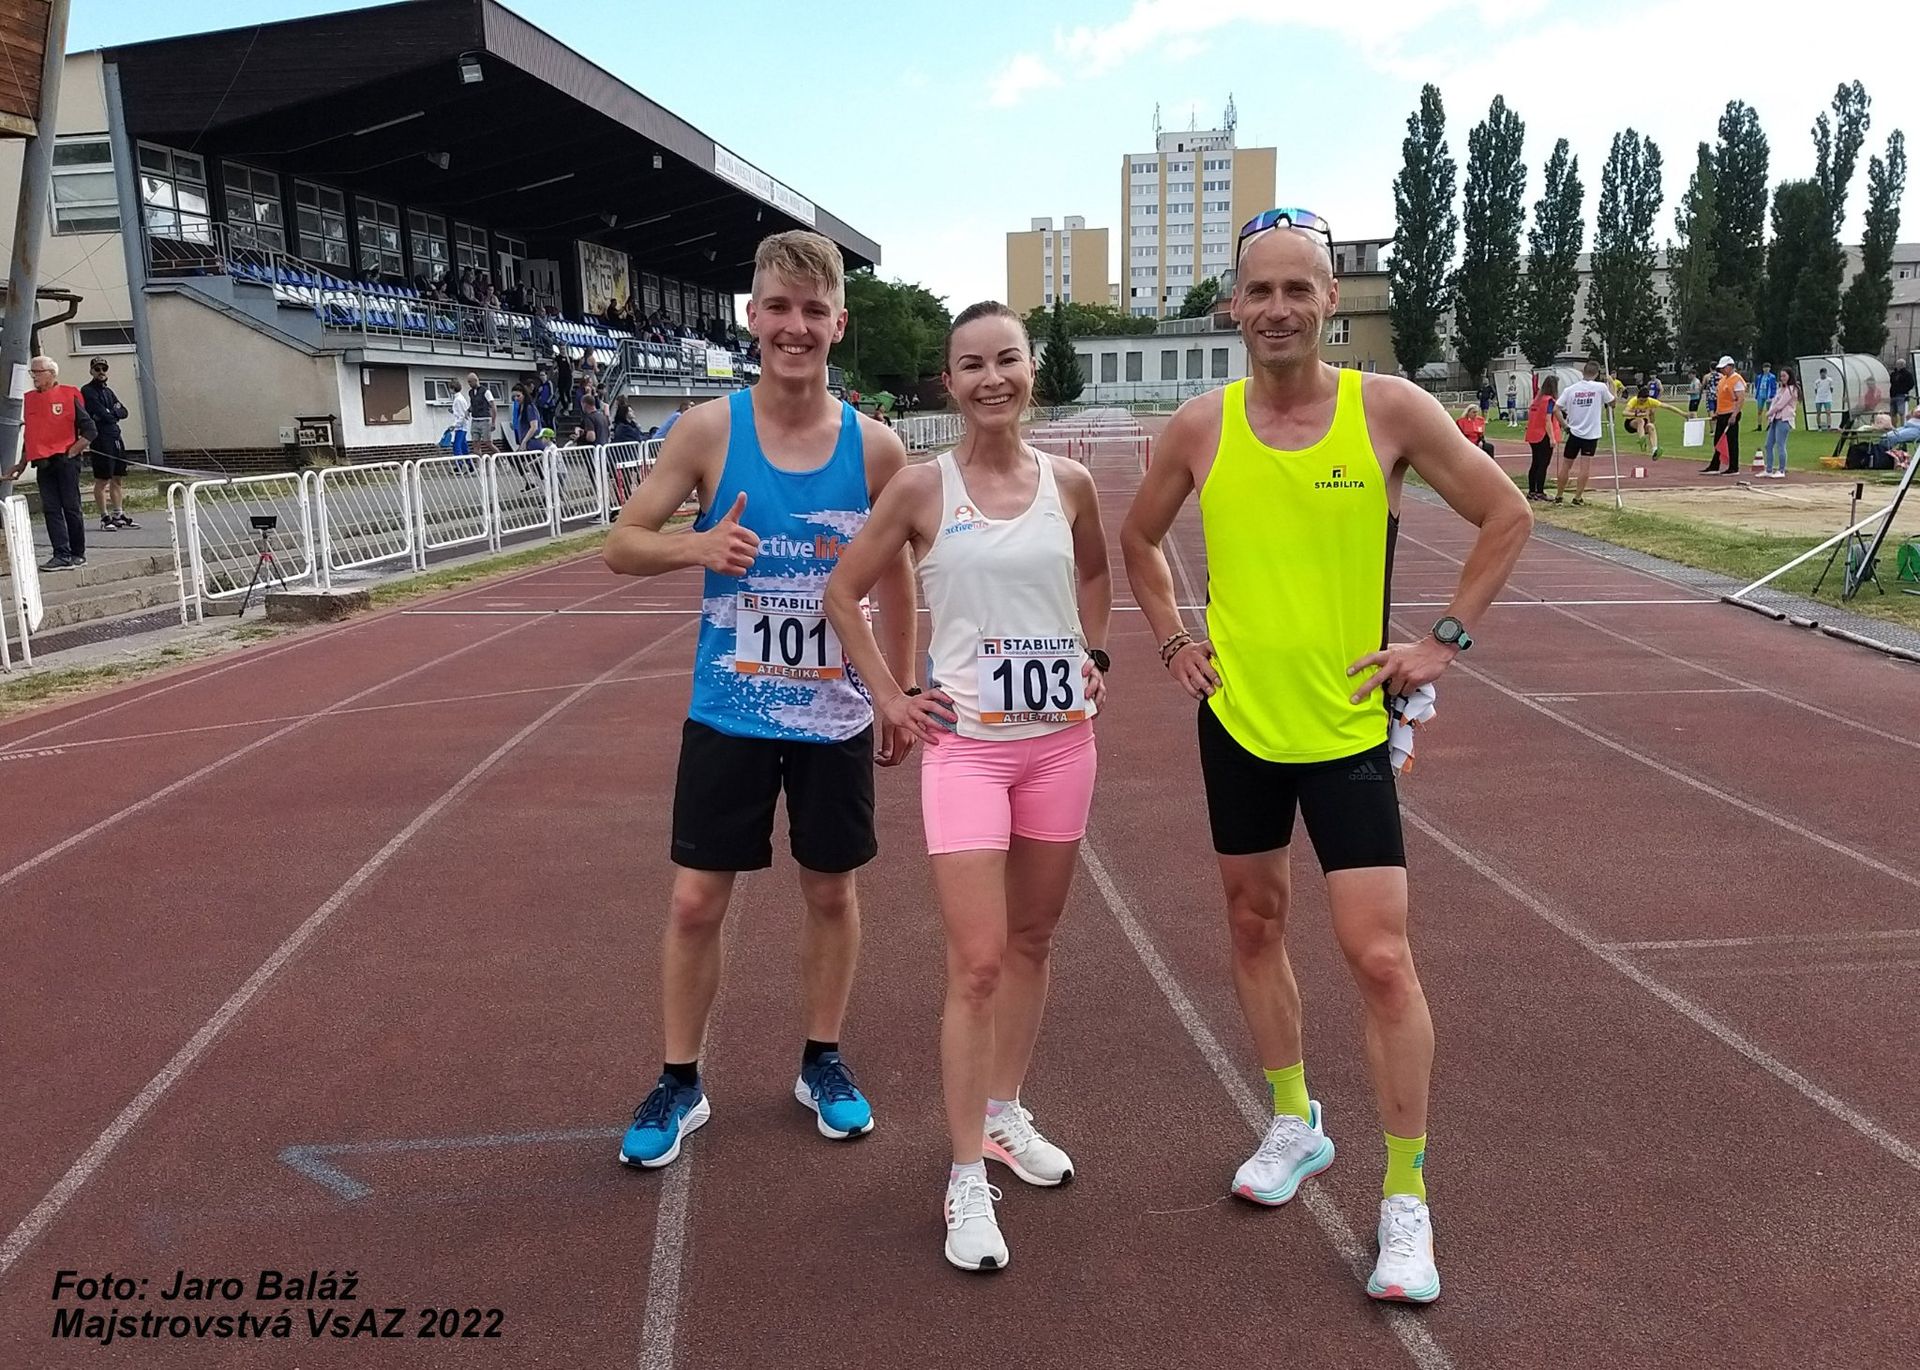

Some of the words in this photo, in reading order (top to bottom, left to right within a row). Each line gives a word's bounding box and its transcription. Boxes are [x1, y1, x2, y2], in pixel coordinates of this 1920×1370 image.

[1314, 481, 1365, 489] STABILITA
[758, 534, 844, 560] ctivelif
[760, 596, 824, 610] STABILI
[754, 615, 827, 667] 101
[1003, 638, 1075, 650] STABILITA
[757, 664, 820, 679] ATLETIKA
[993, 658, 1074, 711] 103
[1003, 712, 1068, 723] ATLETIKA
